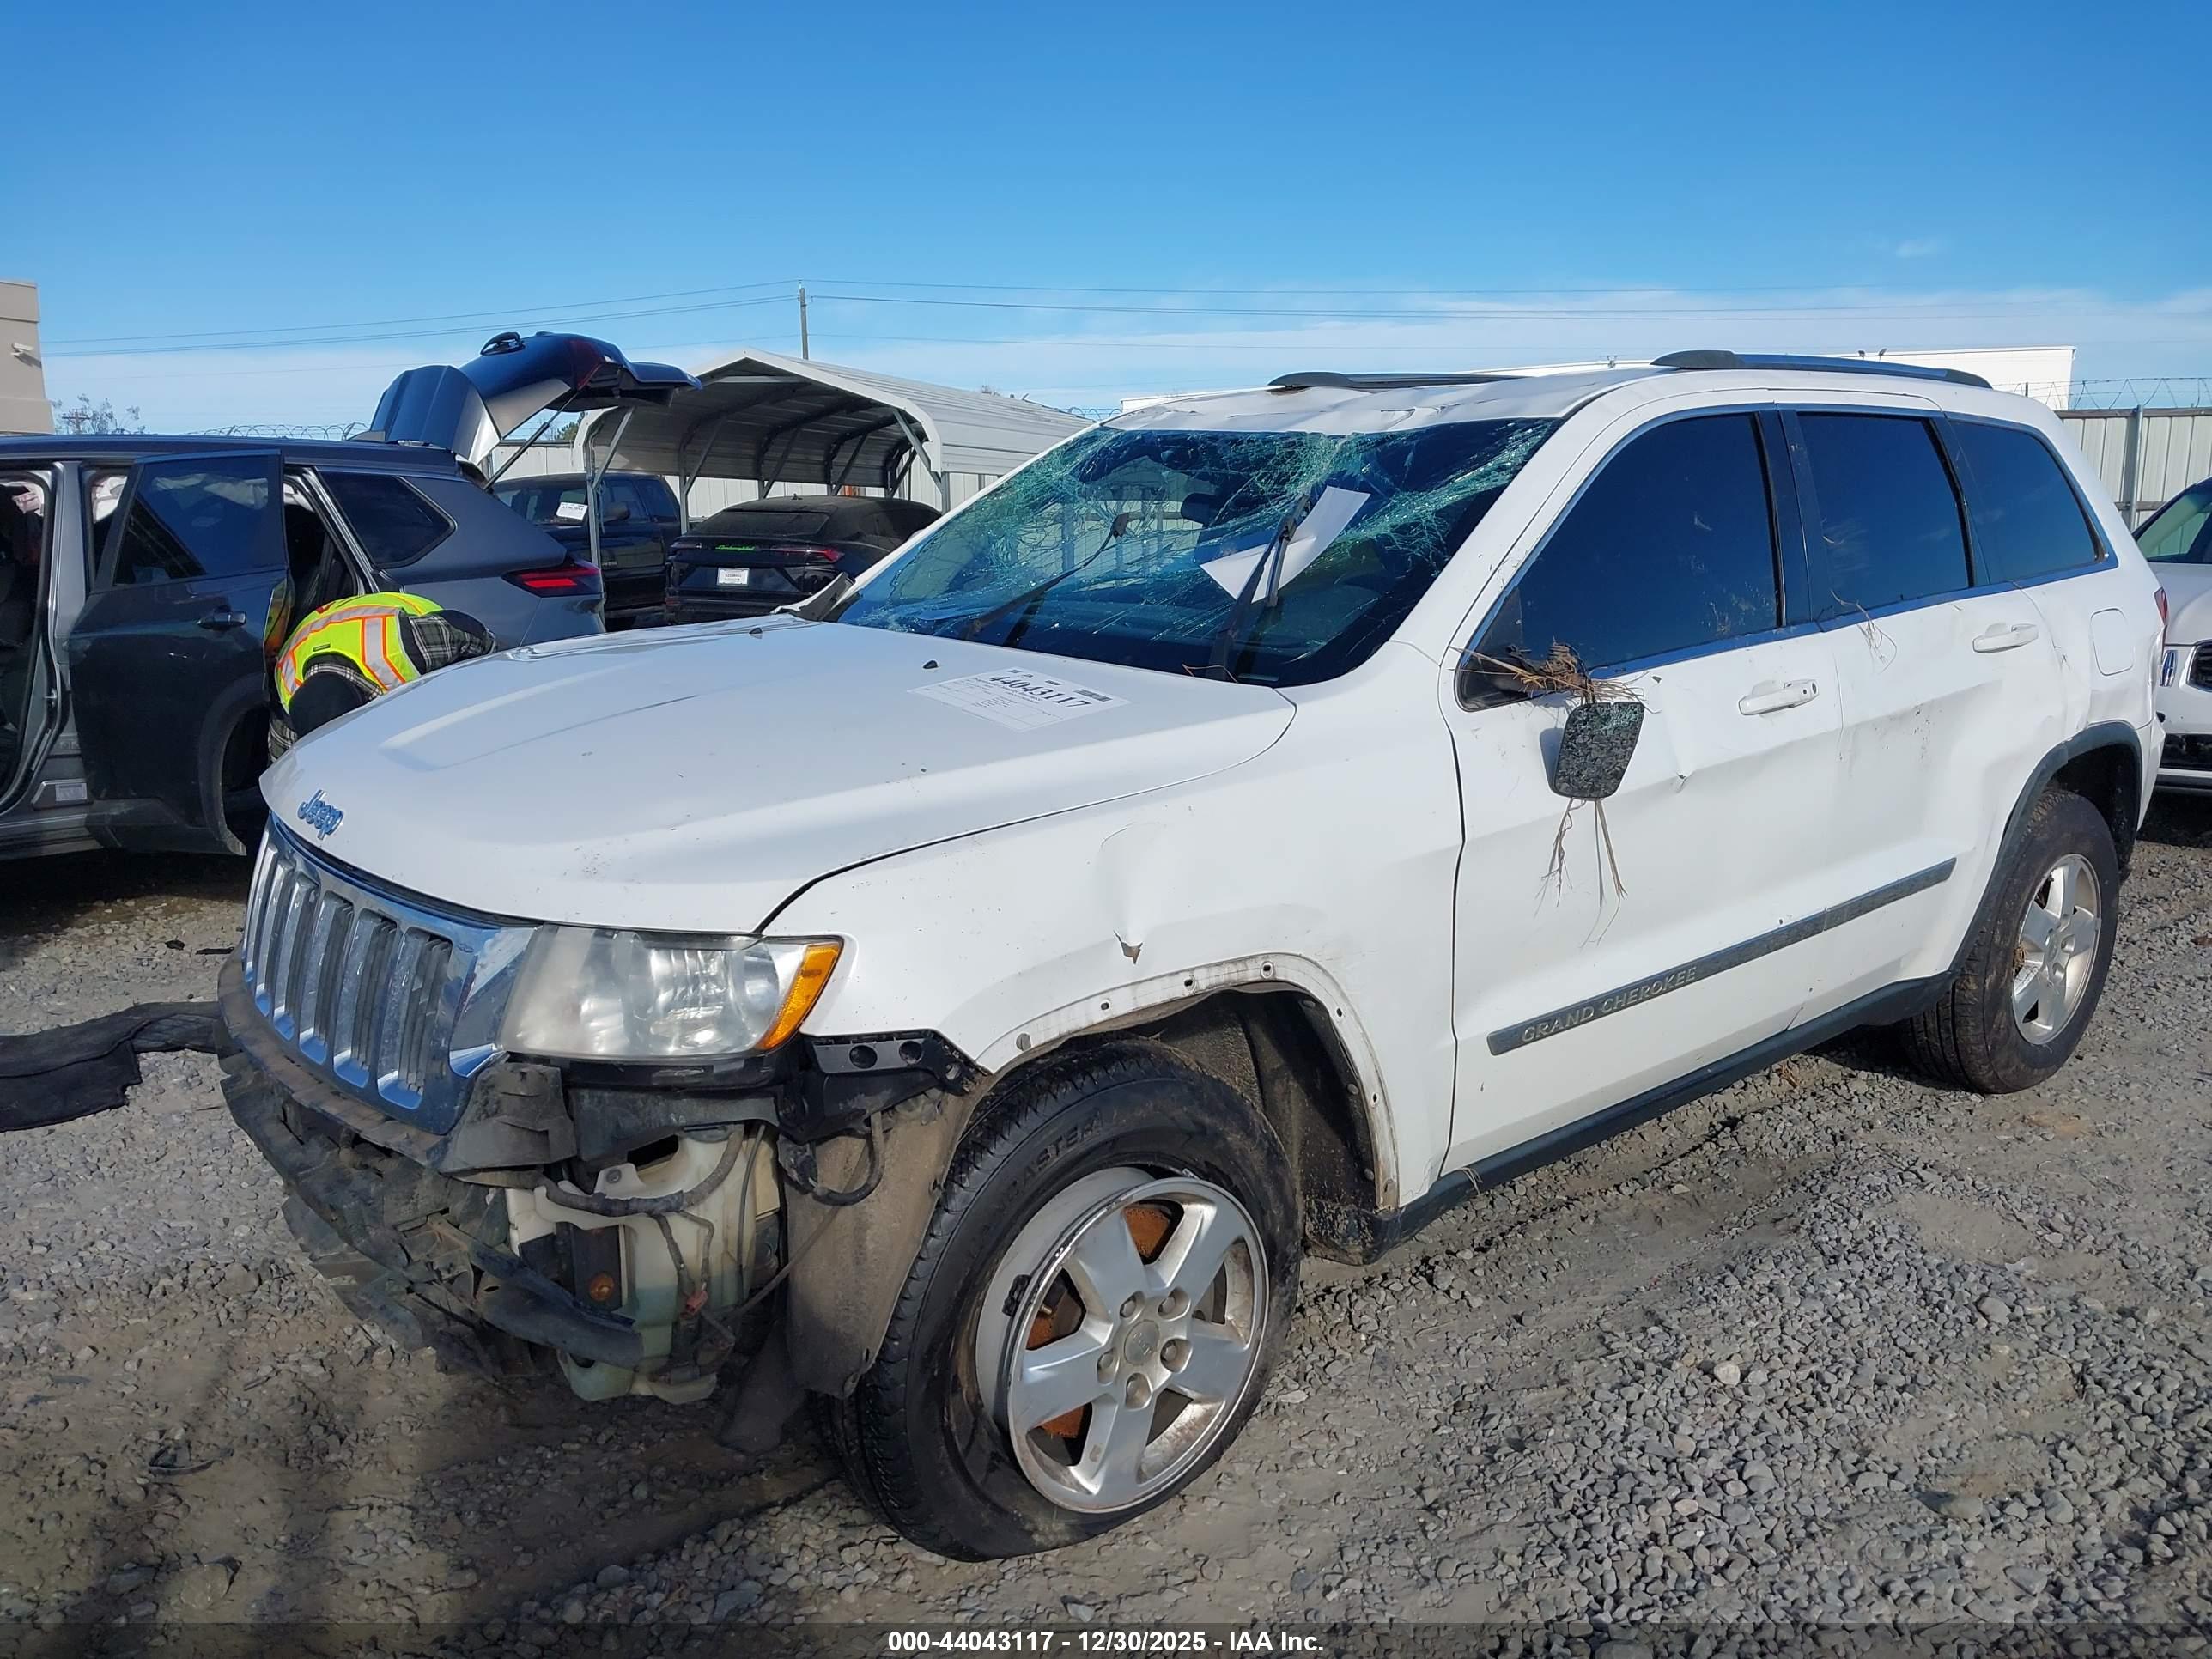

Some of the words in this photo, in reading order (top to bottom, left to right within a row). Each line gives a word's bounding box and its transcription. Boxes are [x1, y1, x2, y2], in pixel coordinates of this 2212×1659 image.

[988, 676, 1093, 708] 44043117
[297, 789, 344, 841] Jeep
[1521, 1006, 1595, 1043] GRAND
[1600, 966, 1698, 1014] CHEROKEE
